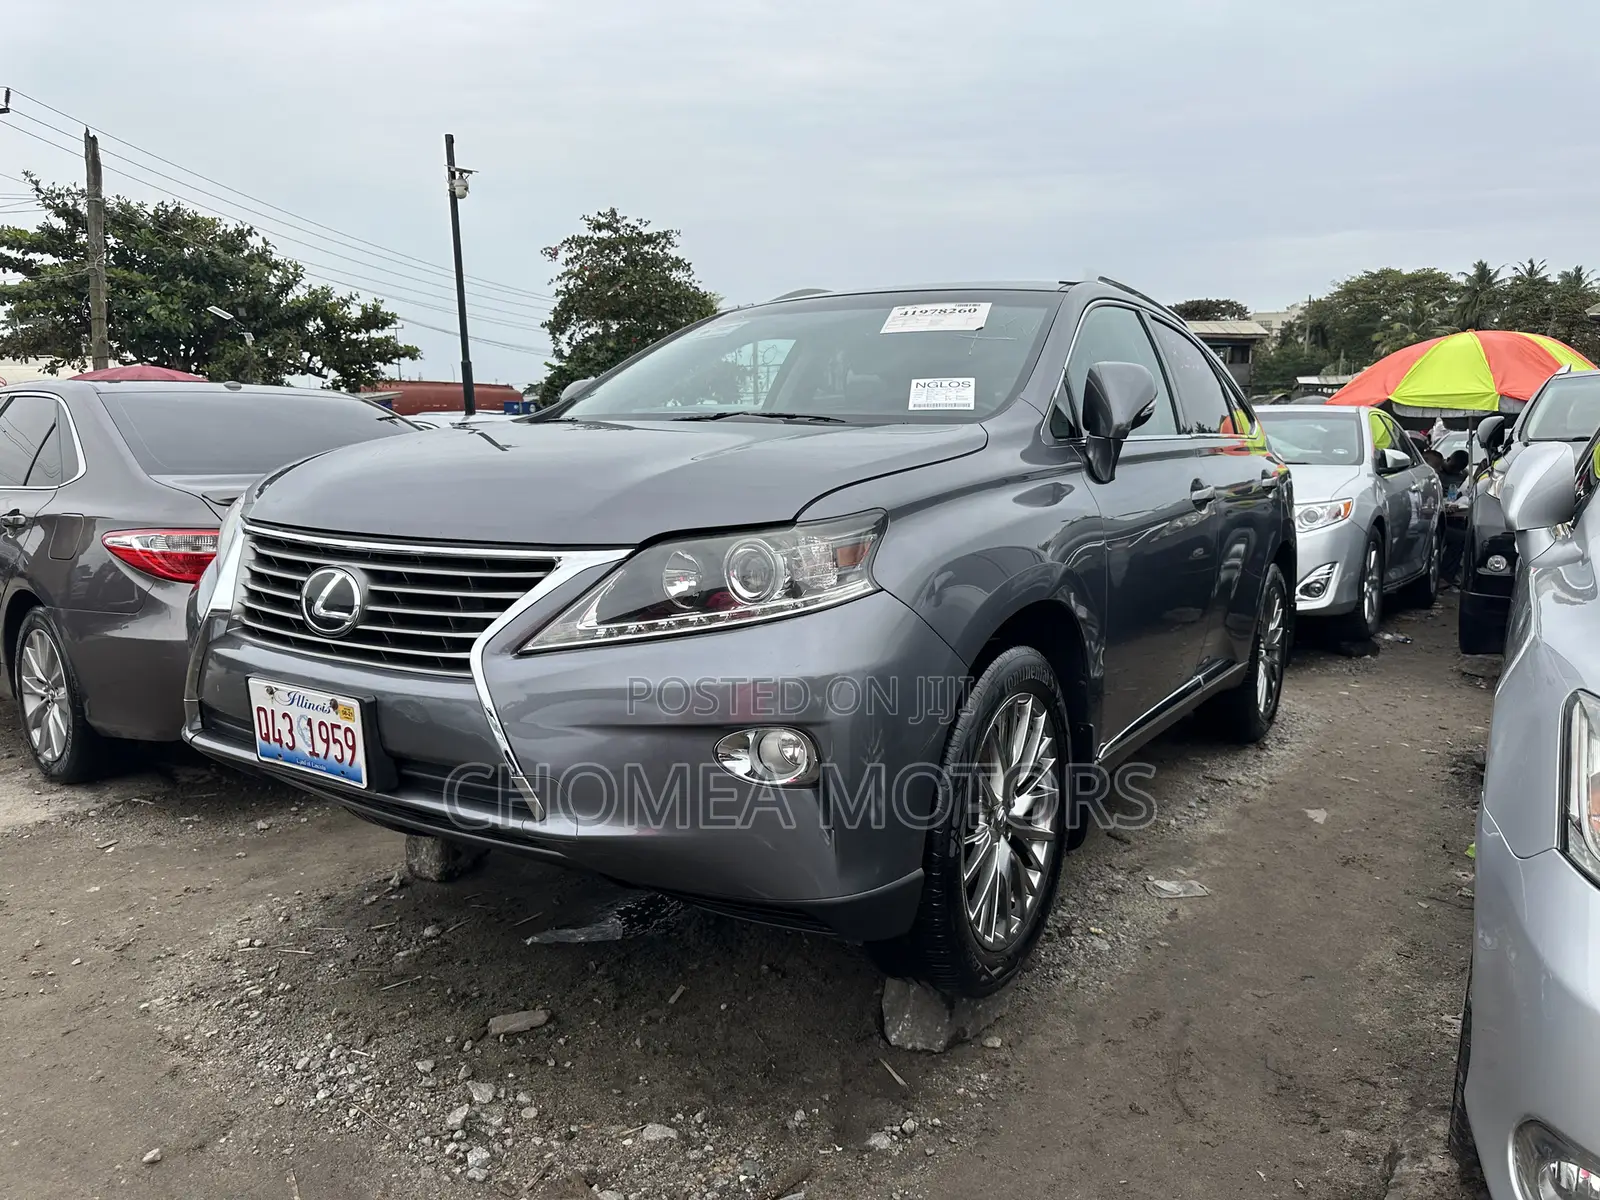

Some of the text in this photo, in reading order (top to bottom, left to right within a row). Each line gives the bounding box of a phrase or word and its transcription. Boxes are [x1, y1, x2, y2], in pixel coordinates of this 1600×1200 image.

[915, 381, 971, 389] NGLOS
[274, 690, 332, 715] Illinois
[256, 706, 357, 767] Q43 1959
